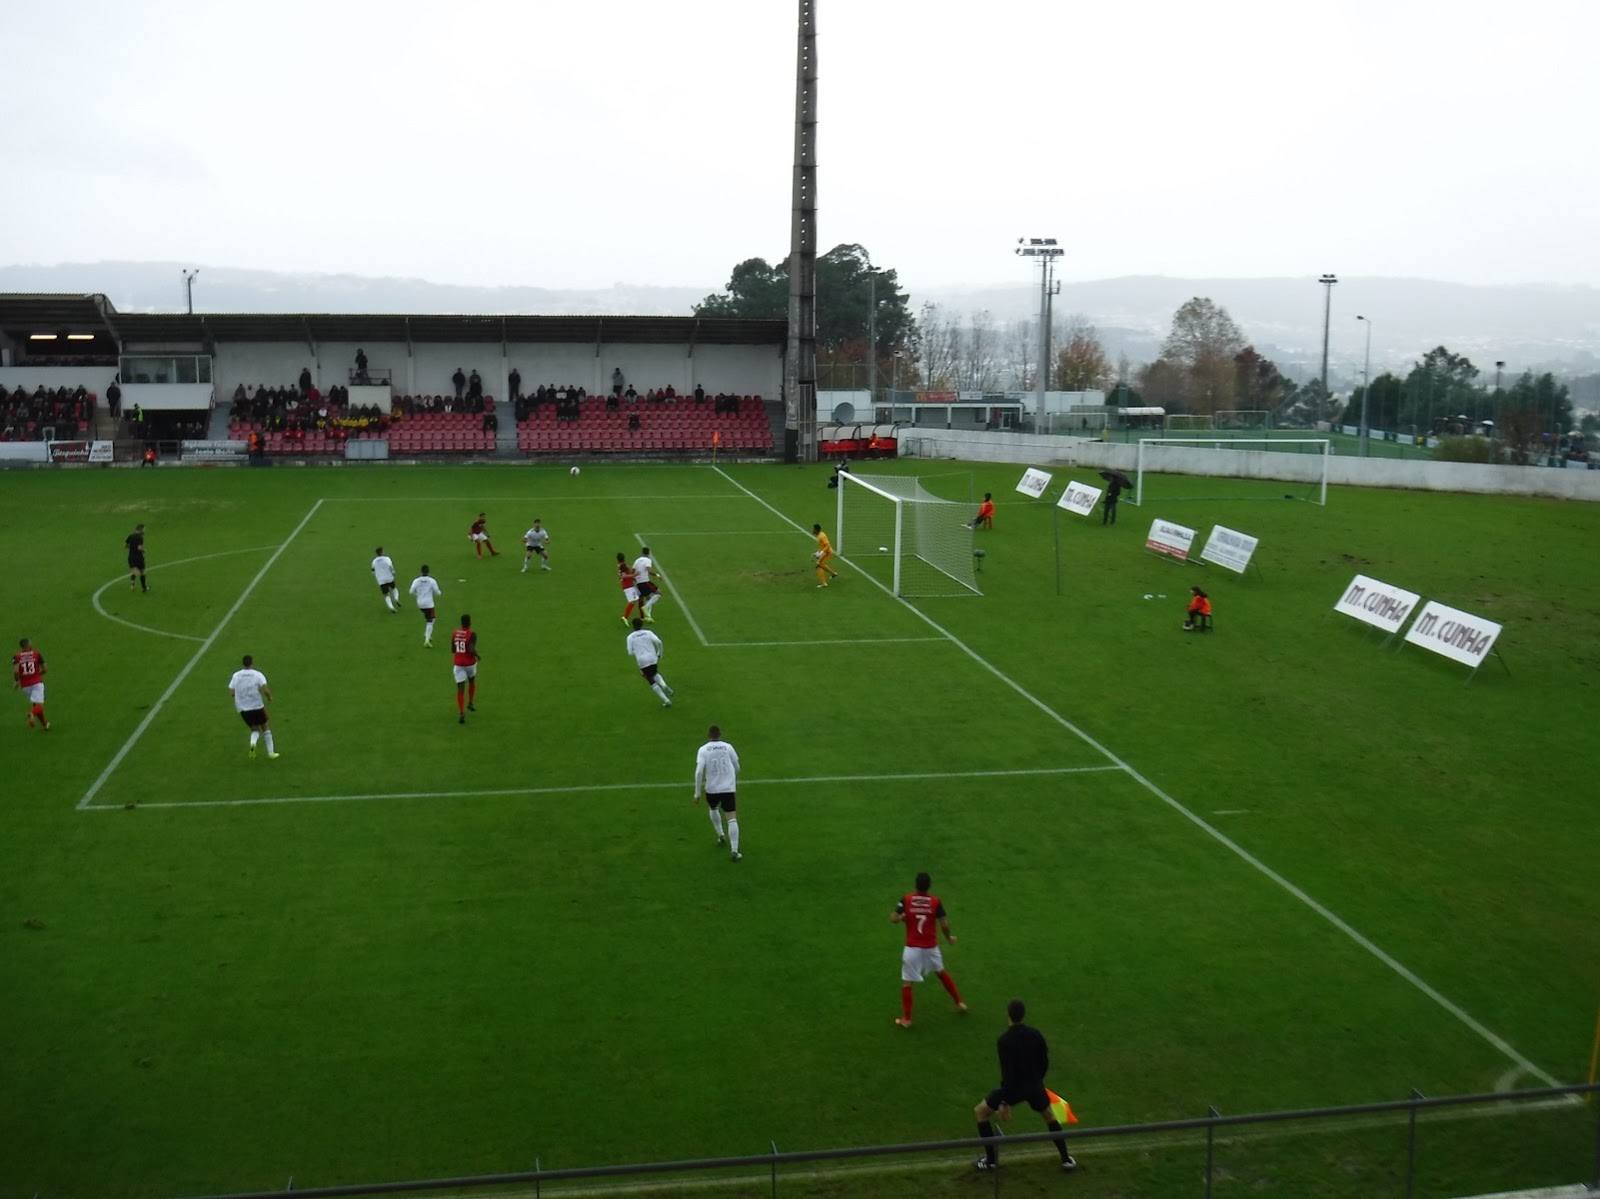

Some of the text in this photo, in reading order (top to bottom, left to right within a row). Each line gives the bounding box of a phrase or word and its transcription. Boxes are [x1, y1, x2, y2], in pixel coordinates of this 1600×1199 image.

[455, 641, 466, 653] 19
[22, 662, 35, 675] 13
[915, 914, 927, 934] 7
